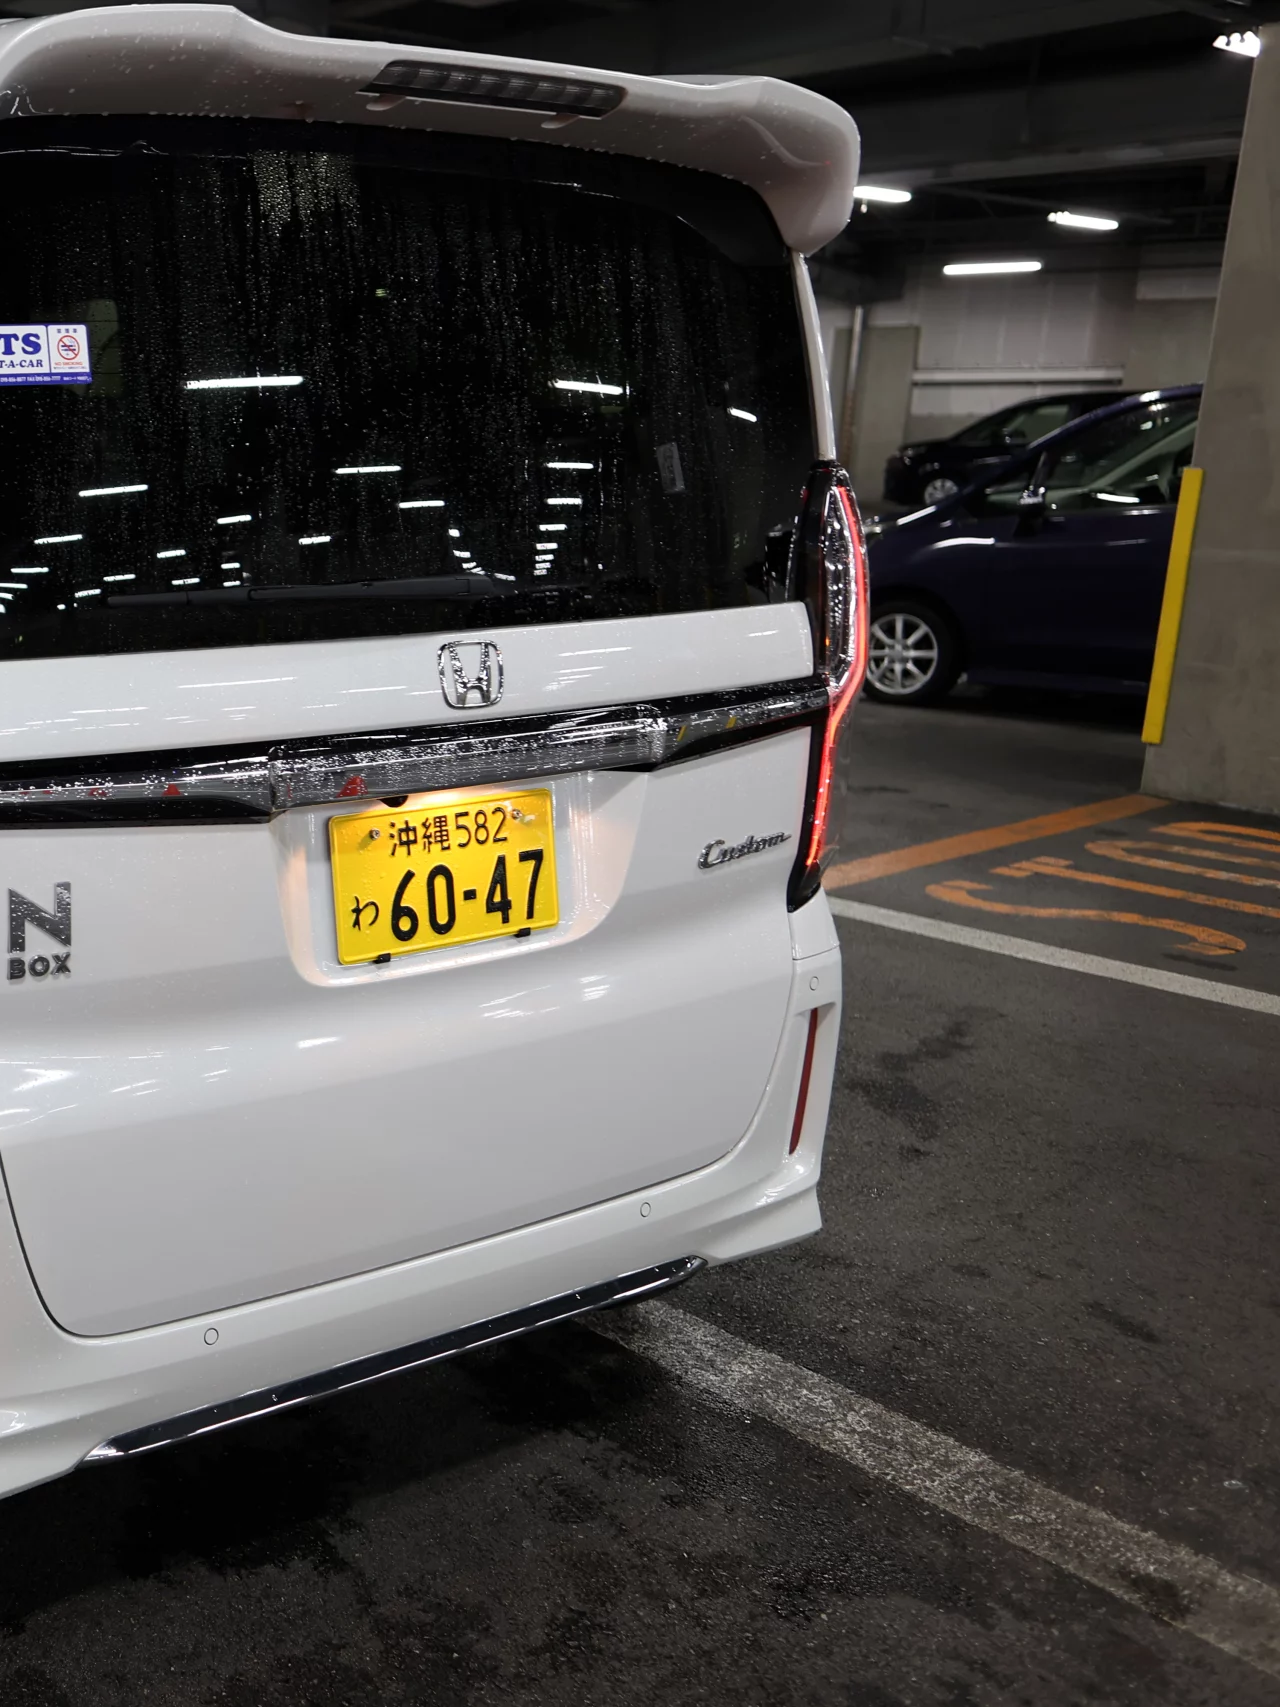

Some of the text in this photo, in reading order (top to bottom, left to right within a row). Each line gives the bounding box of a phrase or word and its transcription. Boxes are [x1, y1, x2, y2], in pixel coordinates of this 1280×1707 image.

[698, 831, 792, 869] Custom
[7, 882, 72, 954] N
[351, 848, 544, 941] わ 60-47
[7, 952, 72, 980] BOX
